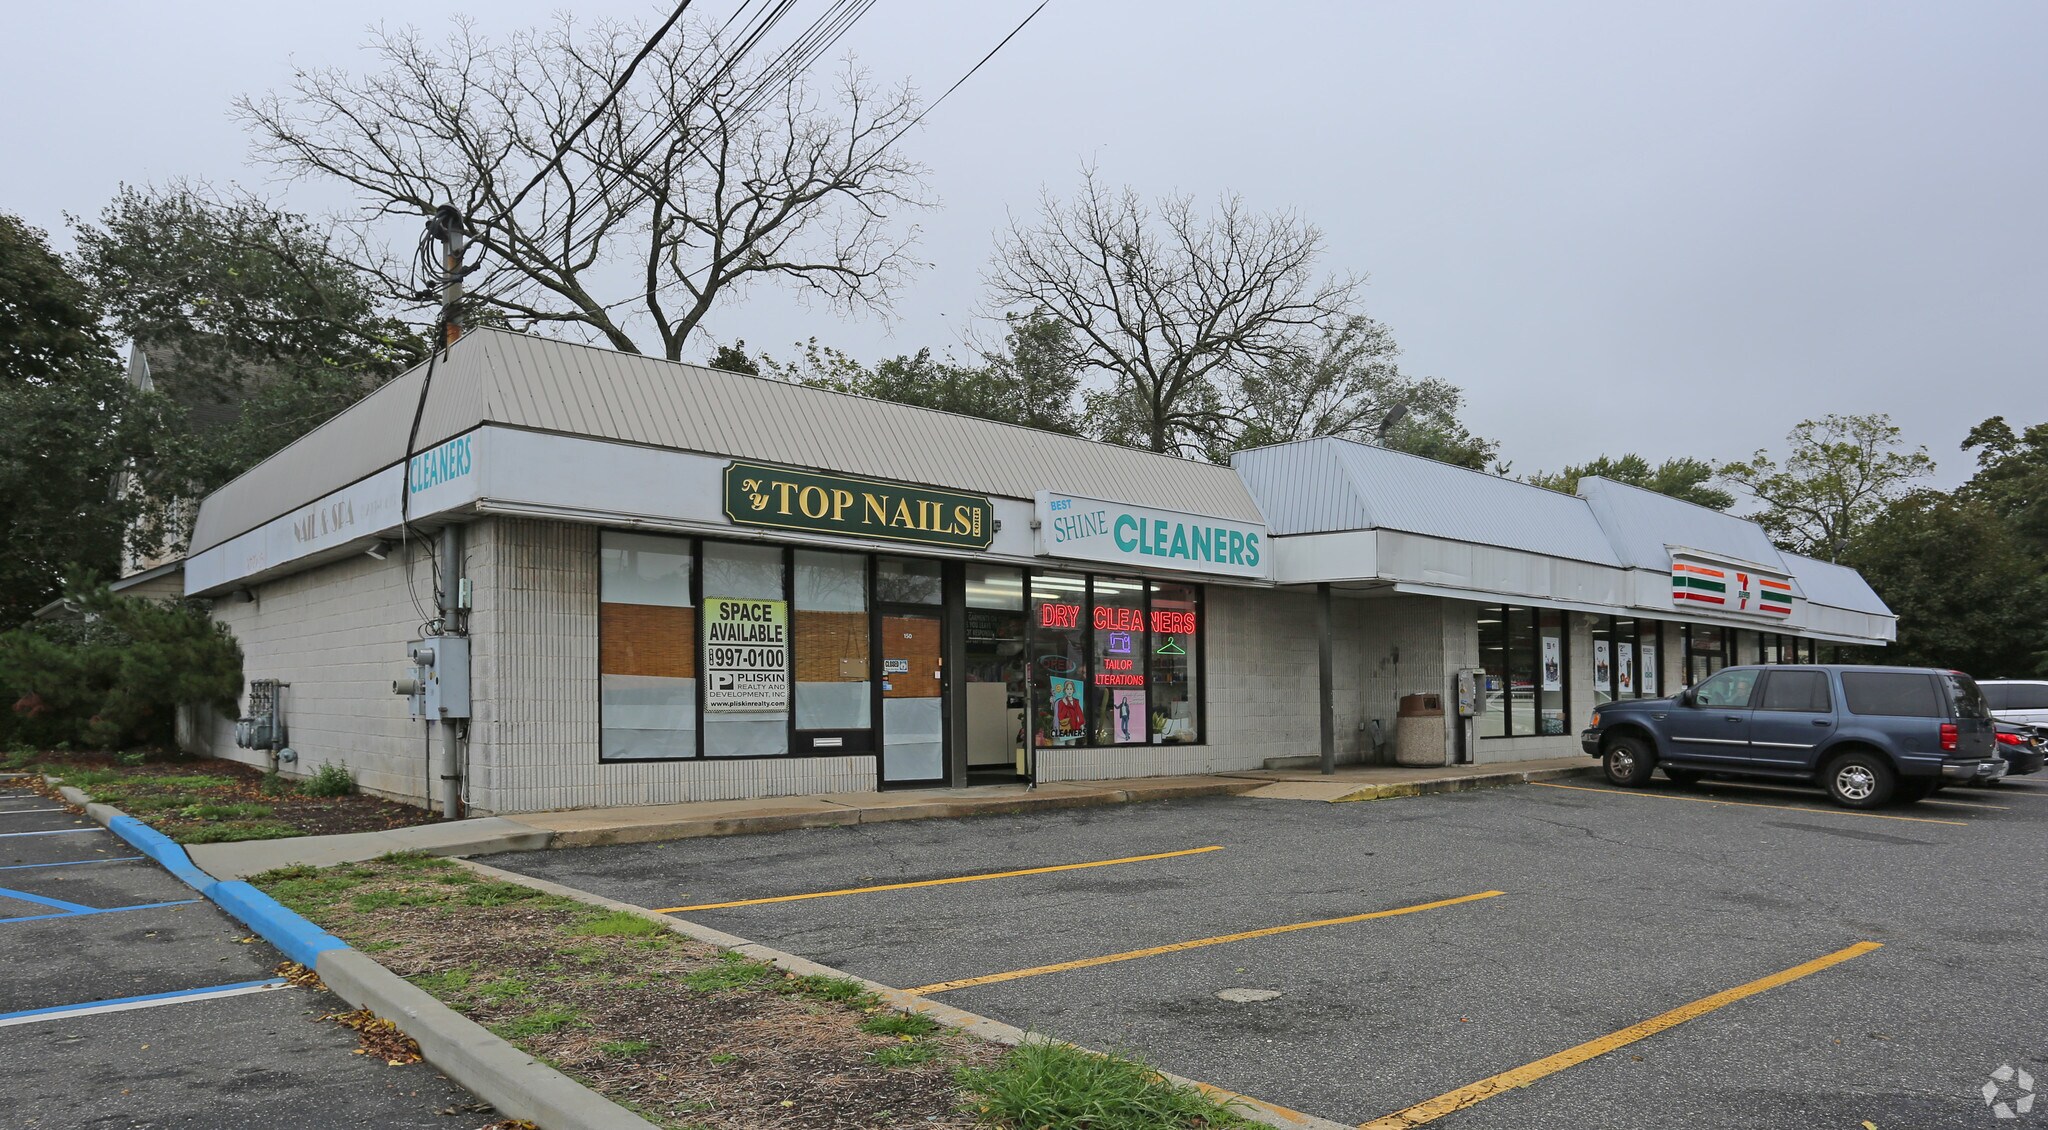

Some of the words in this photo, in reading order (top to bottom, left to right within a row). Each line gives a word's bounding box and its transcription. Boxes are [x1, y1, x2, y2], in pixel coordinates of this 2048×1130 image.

[410, 434, 472, 494] CLEANERS
[771, 481, 854, 521] TOP
[861, 492, 971, 536] NAILS
[1051, 499, 1072, 511] BEST
[1054, 510, 1108, 543] SHINE
[1114, 513, 1260, 567] CLEANERS
[720, 602, 772, 622] SPACE
[1042, 603, 1080, 628] DRY
[710, 622, 783, 642] AVAILABLE
[715, 648, 784, 668] 997-0100
[1104, 658, 1132, 670] TAILOR
[737, 673, 785, 682] PLISKIN
[1095, 674, 1144, 686] LTERATIONS
[1050, 728, 1087, 738] CLEANERS
